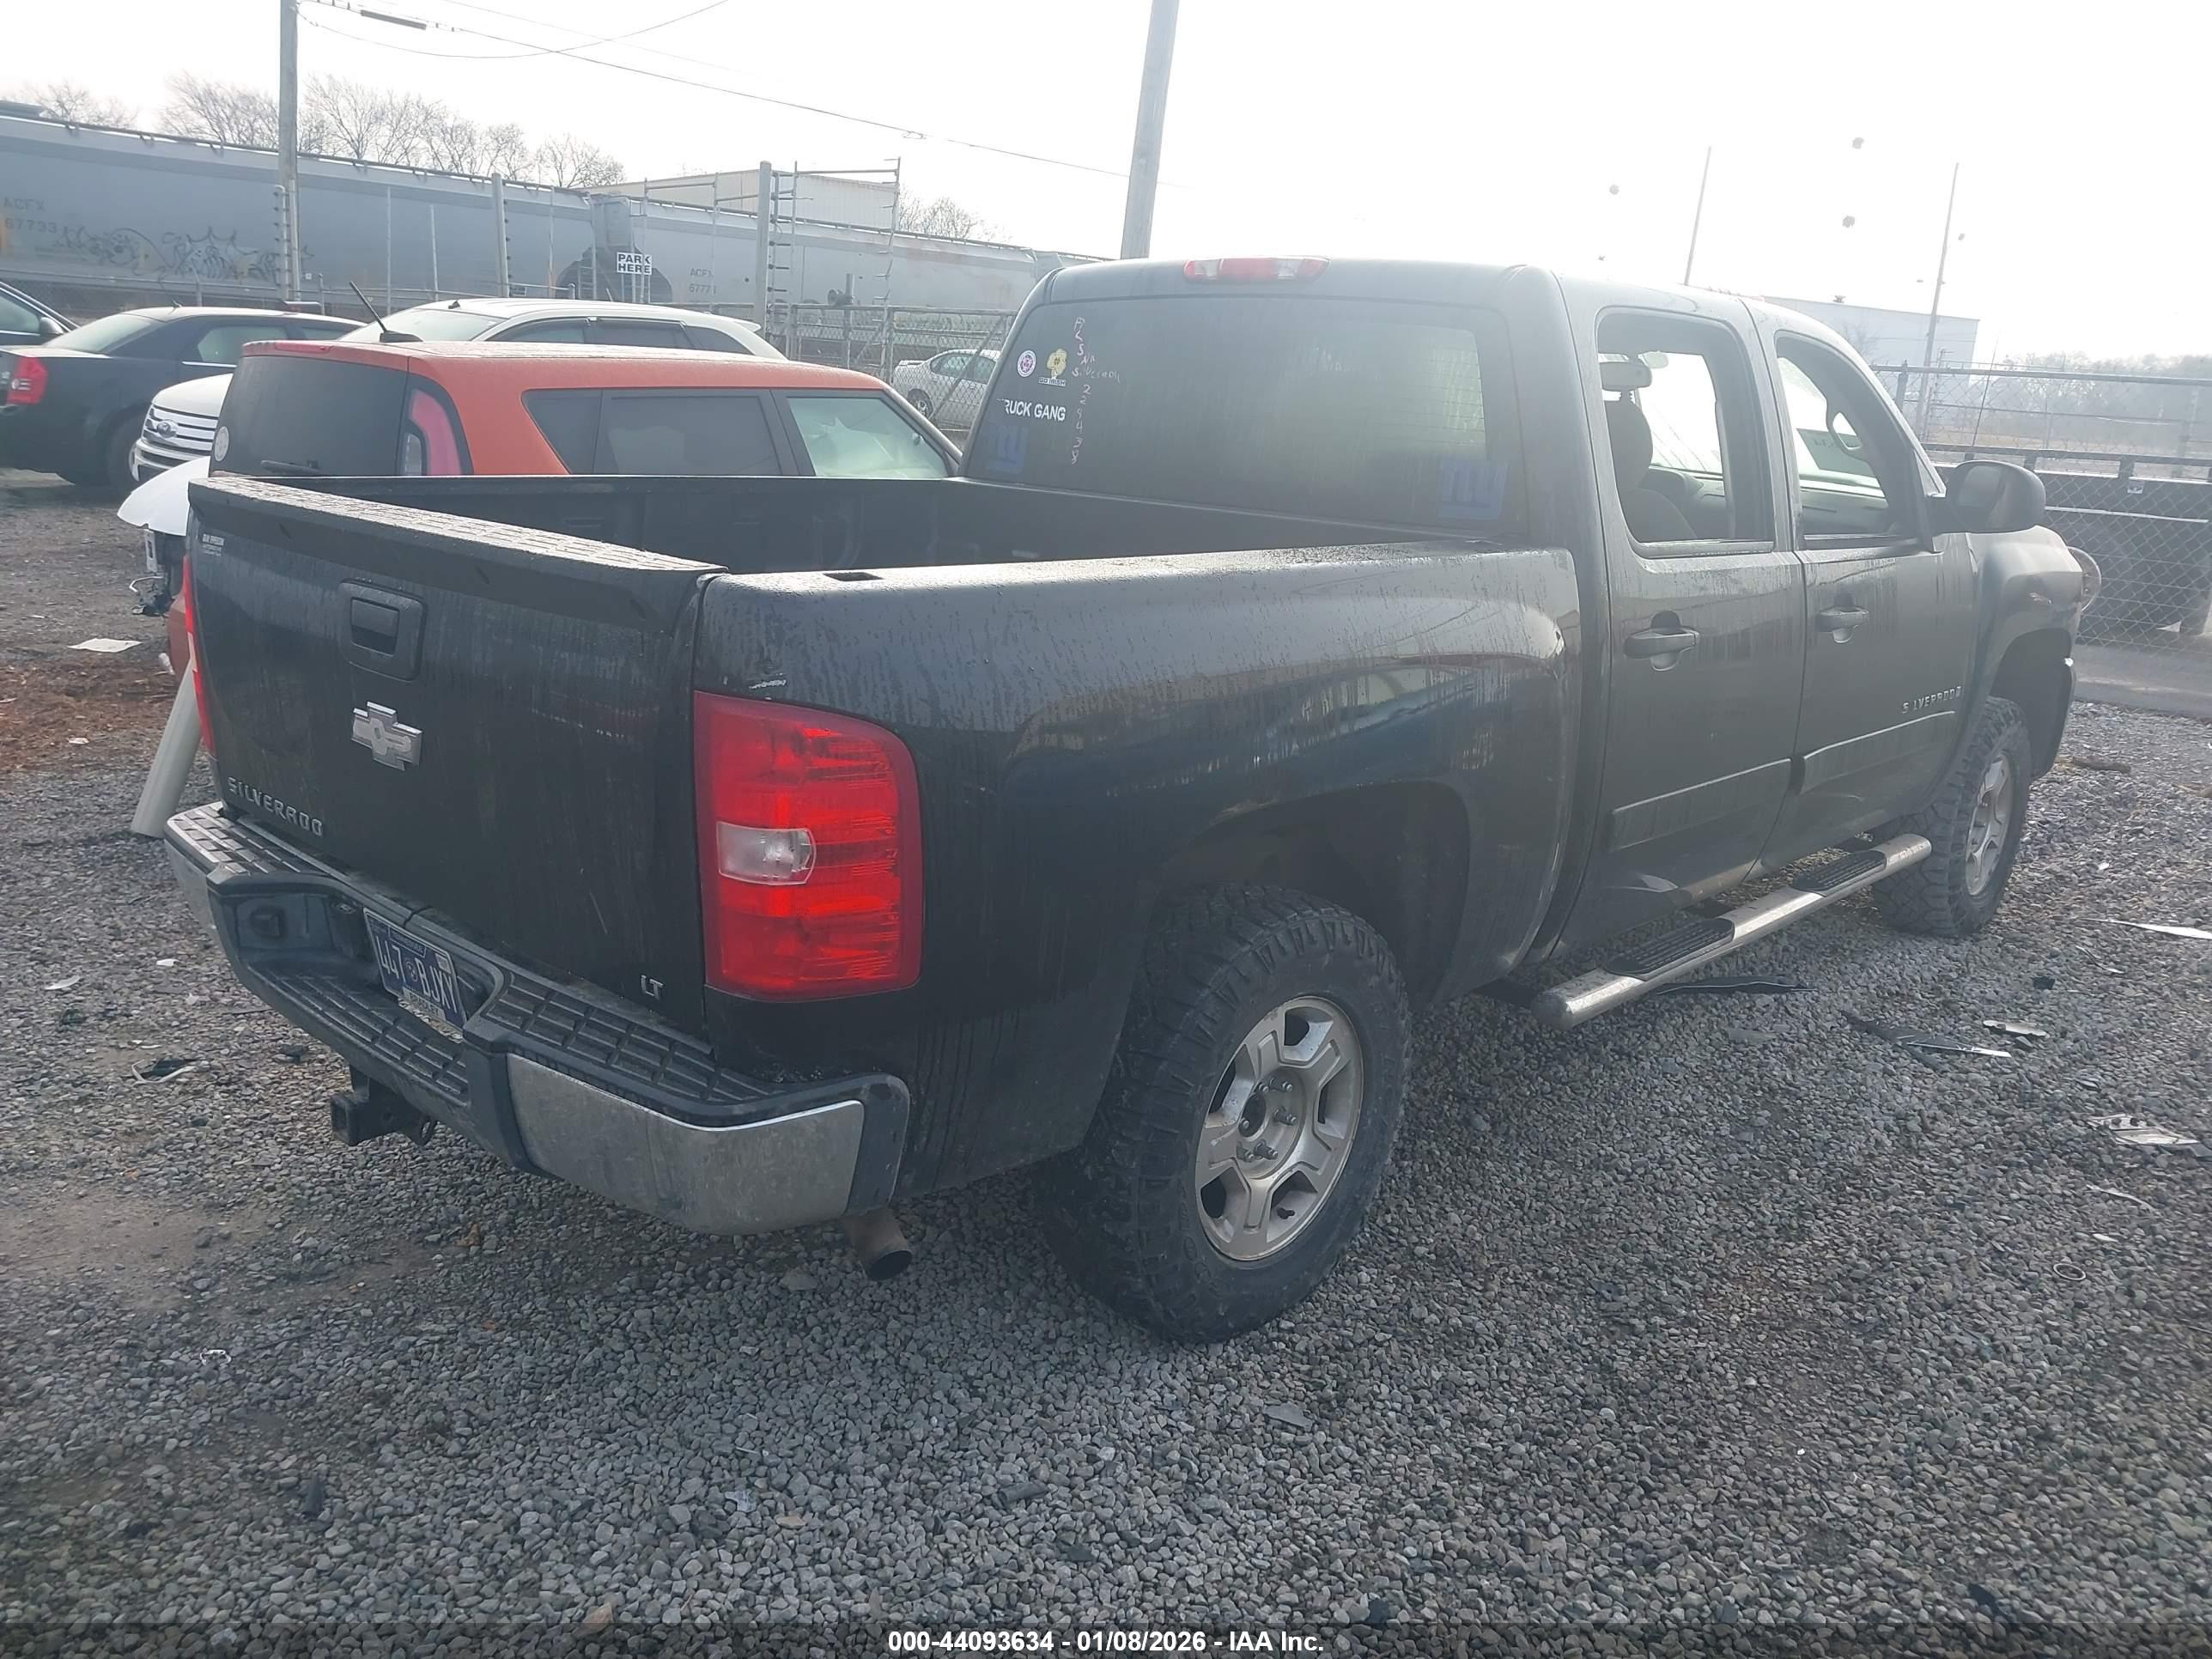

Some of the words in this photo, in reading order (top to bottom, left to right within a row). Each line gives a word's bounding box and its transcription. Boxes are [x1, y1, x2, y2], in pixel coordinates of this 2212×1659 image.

[617, 253, 651, 264] PARK
[617, 263, 651, 274] HERE
[996, 398, 1033, 417] RUCK
[1034, 403, 1066, 422] GANG
[227, 776, 324, 837] SILVERADO
[375, 935, 407, 984] 447
[414, 957, 458, 1014] BJXY
[640, 975, 665, 1000] LT
